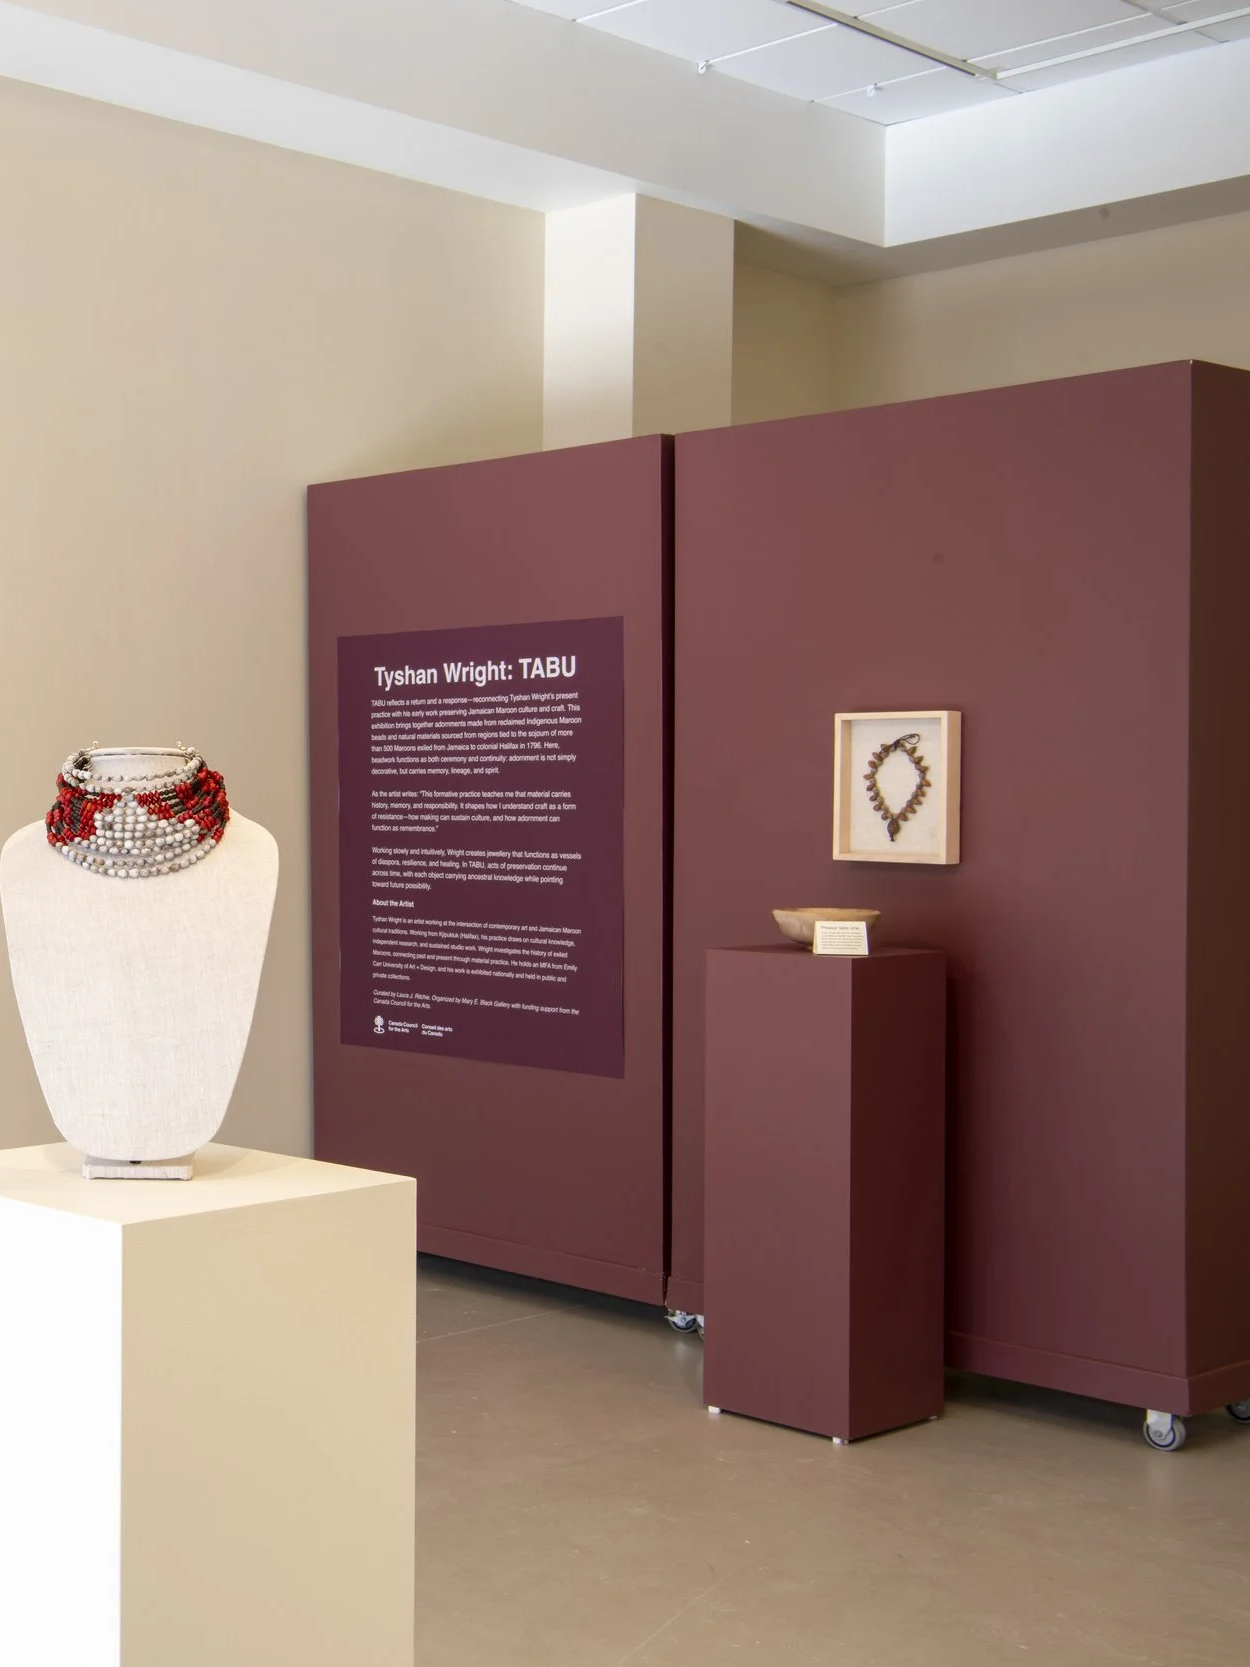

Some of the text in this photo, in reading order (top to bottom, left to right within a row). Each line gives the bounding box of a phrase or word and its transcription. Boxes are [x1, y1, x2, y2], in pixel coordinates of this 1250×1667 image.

[374, 655, 575, 691] Tyshan Wright: TABU
[509, 693, 530, 702] Tyshan
[555, 692, 578, 700] present
[411, 710, 424, 718] early
[438, 709, 467, 717] preserving
[467, 707, 495, 715] Jamaican
[495, 706, 517, 714] Maroon
[517, 705, 538, 713] culture
[567, 703, 580, 711] This
[395, 722, 411, 730] brings
[412, 721, 434, 729] together
[526, 717, 558, 726] Indigenous
[558, 716, 582, 724] Maroon
[528, 730, 549, 738] sojourn
[557, 754, 576, 762] simply
[464, 802, 485, 810] shapes
[419, 814, 439, 822] making
[371, 847, 392, 855] Working
[446, 849, 464, 857] Wright
[486, 850, 511, 858] jewellery
[506, 863, 541, 871] preservation
